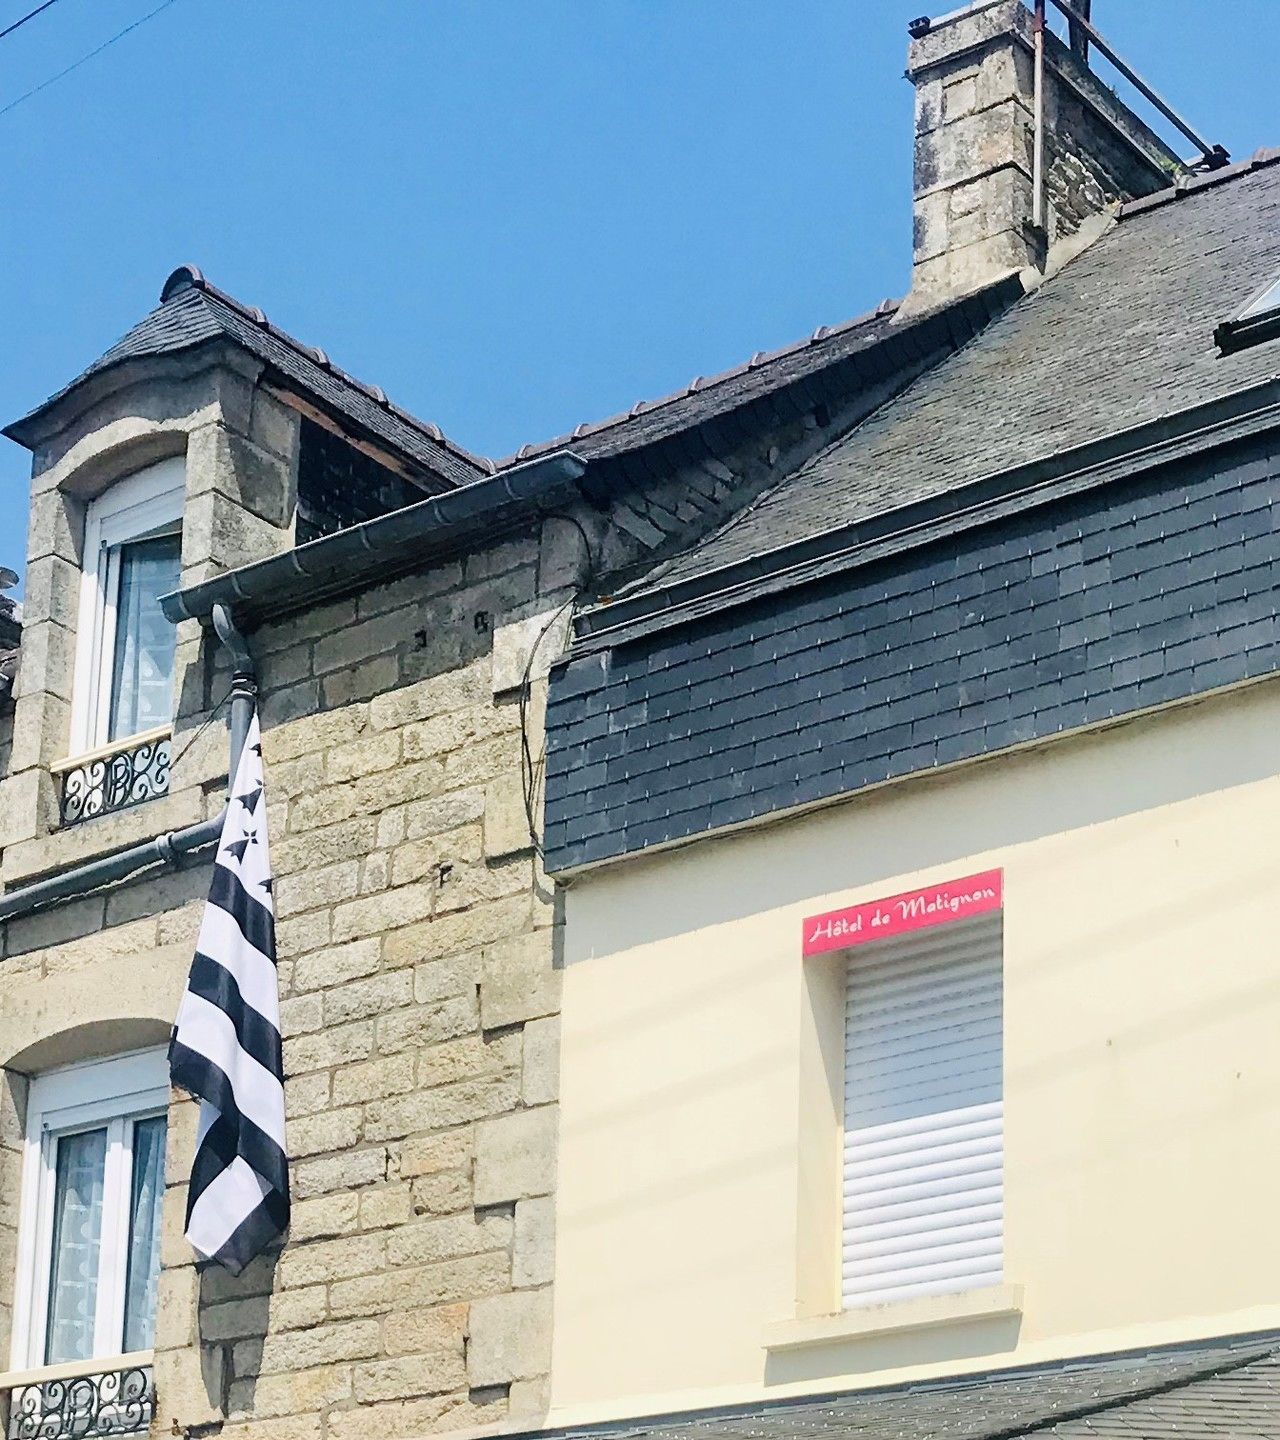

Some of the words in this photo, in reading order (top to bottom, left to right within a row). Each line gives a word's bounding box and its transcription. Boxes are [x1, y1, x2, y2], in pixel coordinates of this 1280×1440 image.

[809, 914, 862, 943] Hôtel
[871, 910, 890, 927] de
[893, 887, 995, 919] Matignon
